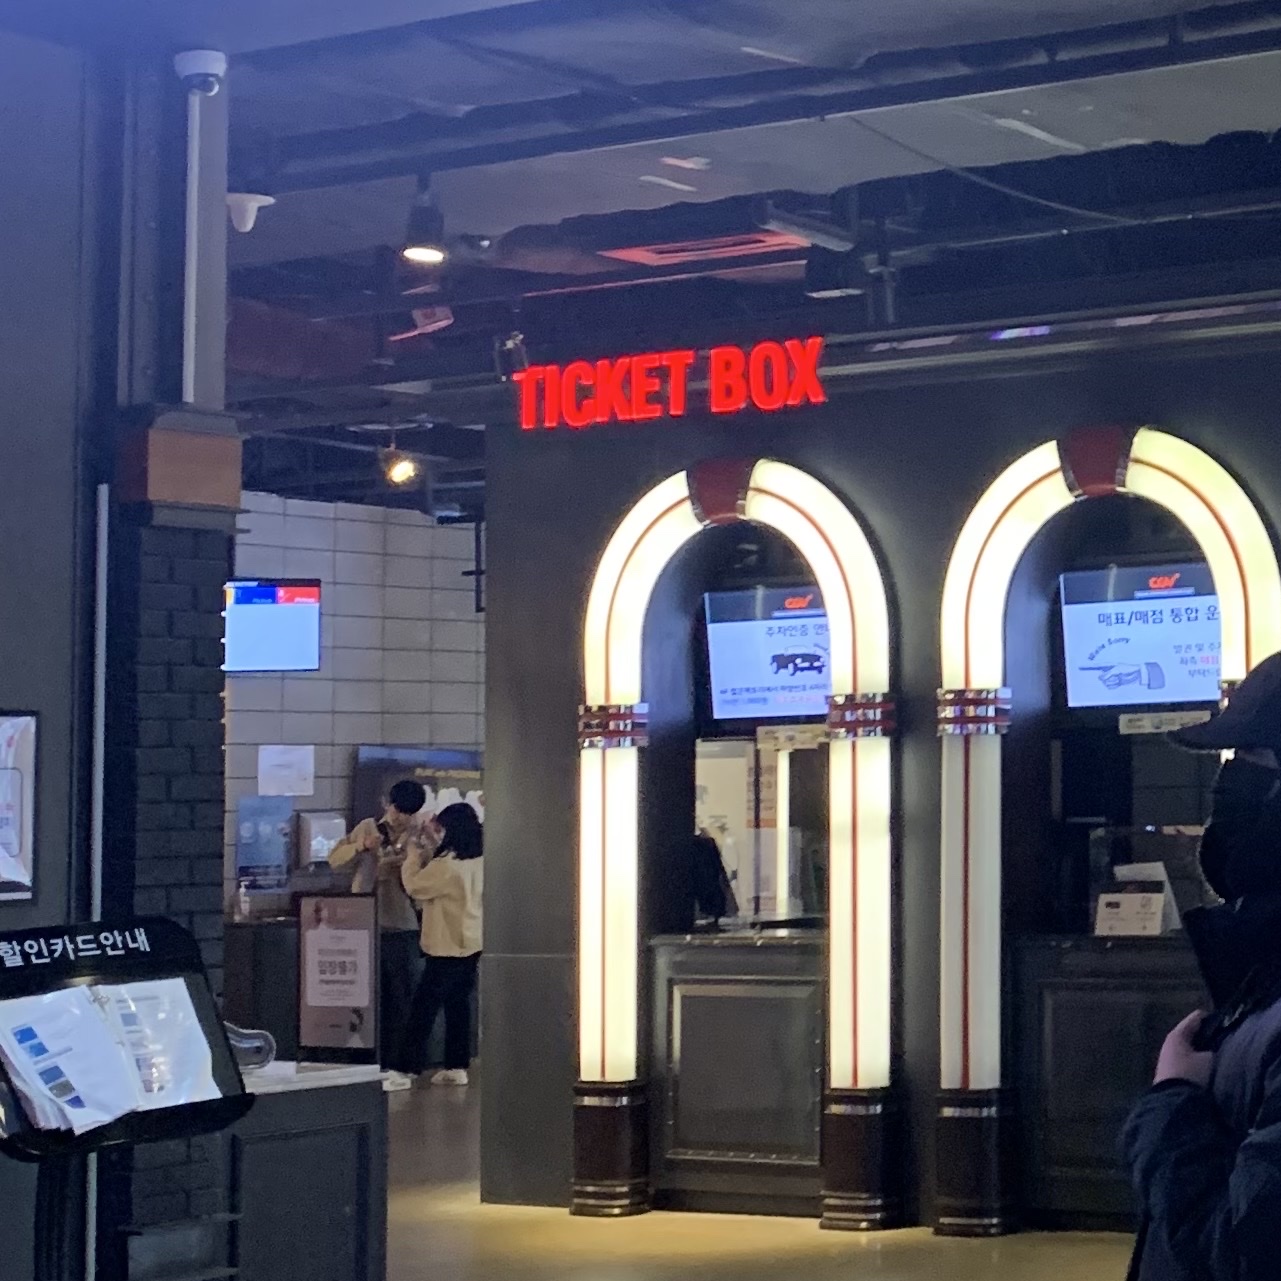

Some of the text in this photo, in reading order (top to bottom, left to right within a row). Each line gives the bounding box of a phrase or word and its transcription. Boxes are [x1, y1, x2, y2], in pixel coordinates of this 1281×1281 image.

[512, 335, 828, 430] TICKET BOX
[0, 927, 151, 968] 할인카드안내
